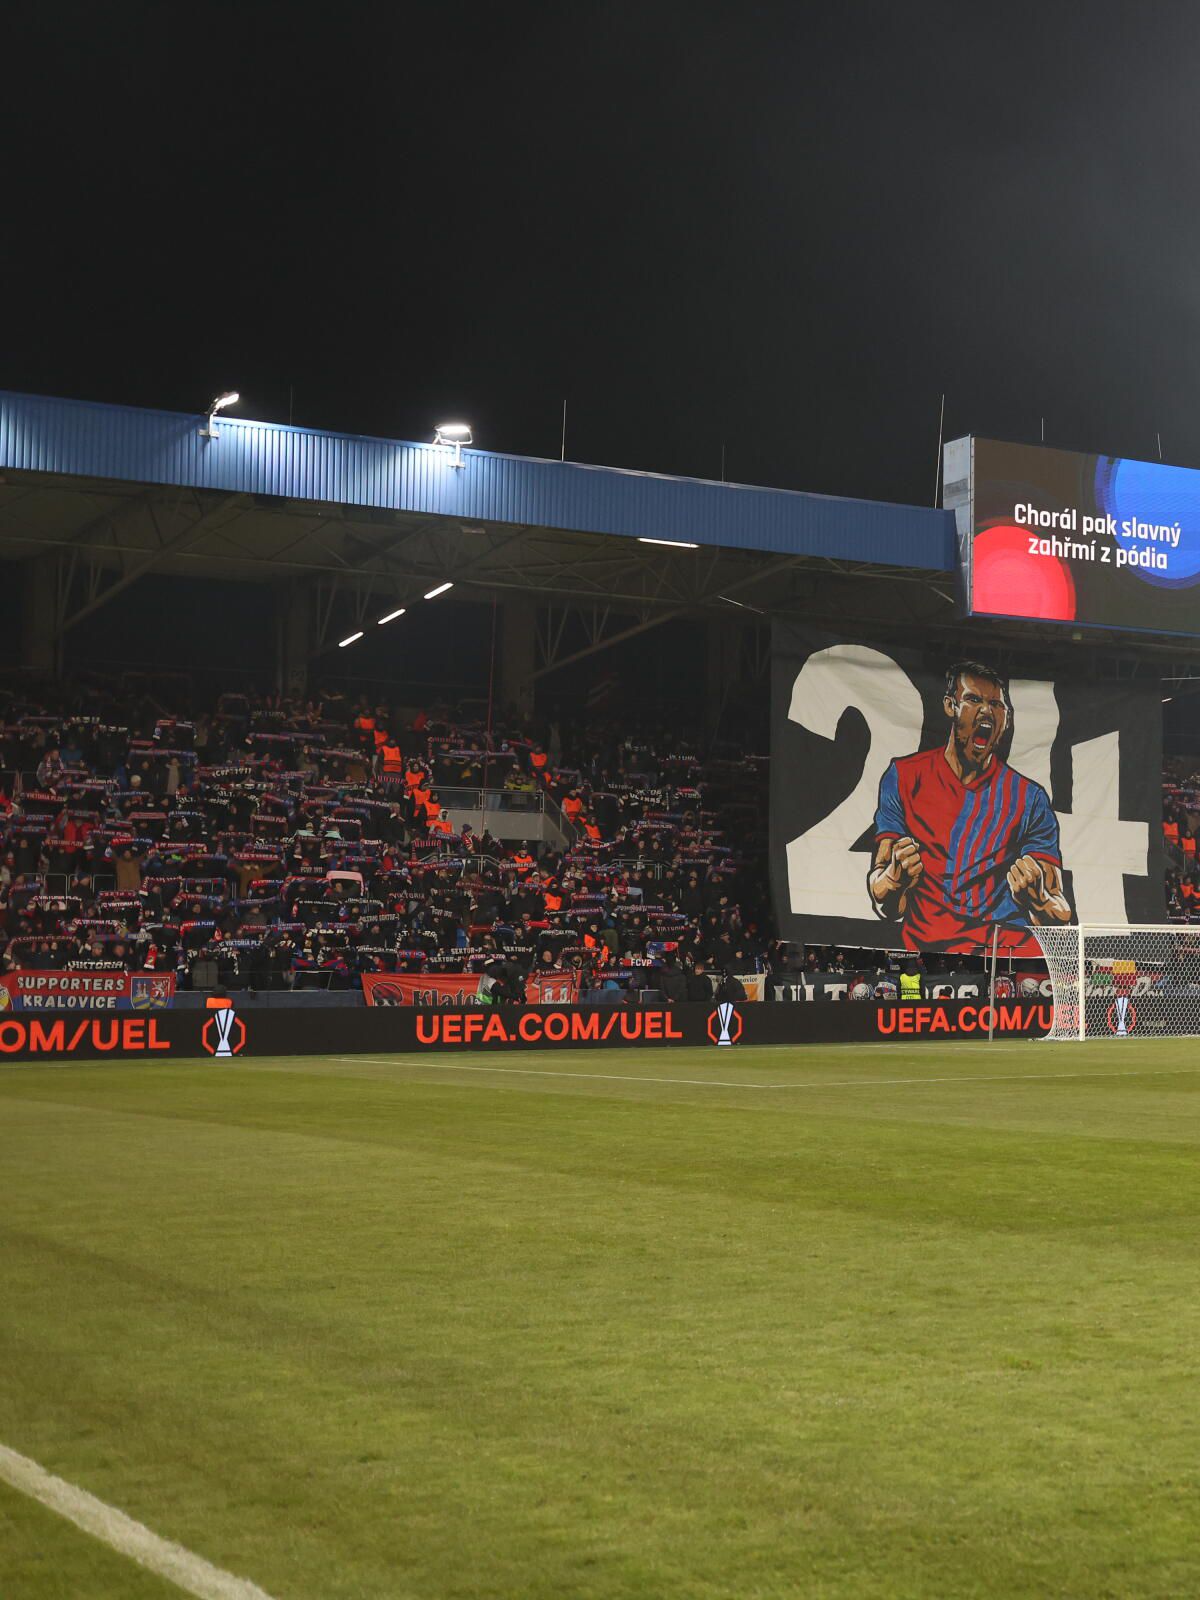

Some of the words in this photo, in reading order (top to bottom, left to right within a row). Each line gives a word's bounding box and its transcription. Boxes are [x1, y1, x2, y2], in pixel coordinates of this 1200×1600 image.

[1014, 503, 1077, 531] Chorál
[1082, 514, 1117, 536] pak
[1121, 517, 1181, 548] slavný
[1028, 534, 1096, 562] zahřmí
[1100, 546, 1110, 563] z
[1116, 546, 1168, 570] pódia
[785, 643, 1149, 925] 24
[18, 977, 125, 991] SUPPORTERS
[23, 995, 116, 1008] KRALOVICE
[416, 1012, 683, 1043] UEFA.COM/UEL
[877, 1005, 1087, 1034] UEFA.COM/UEL
